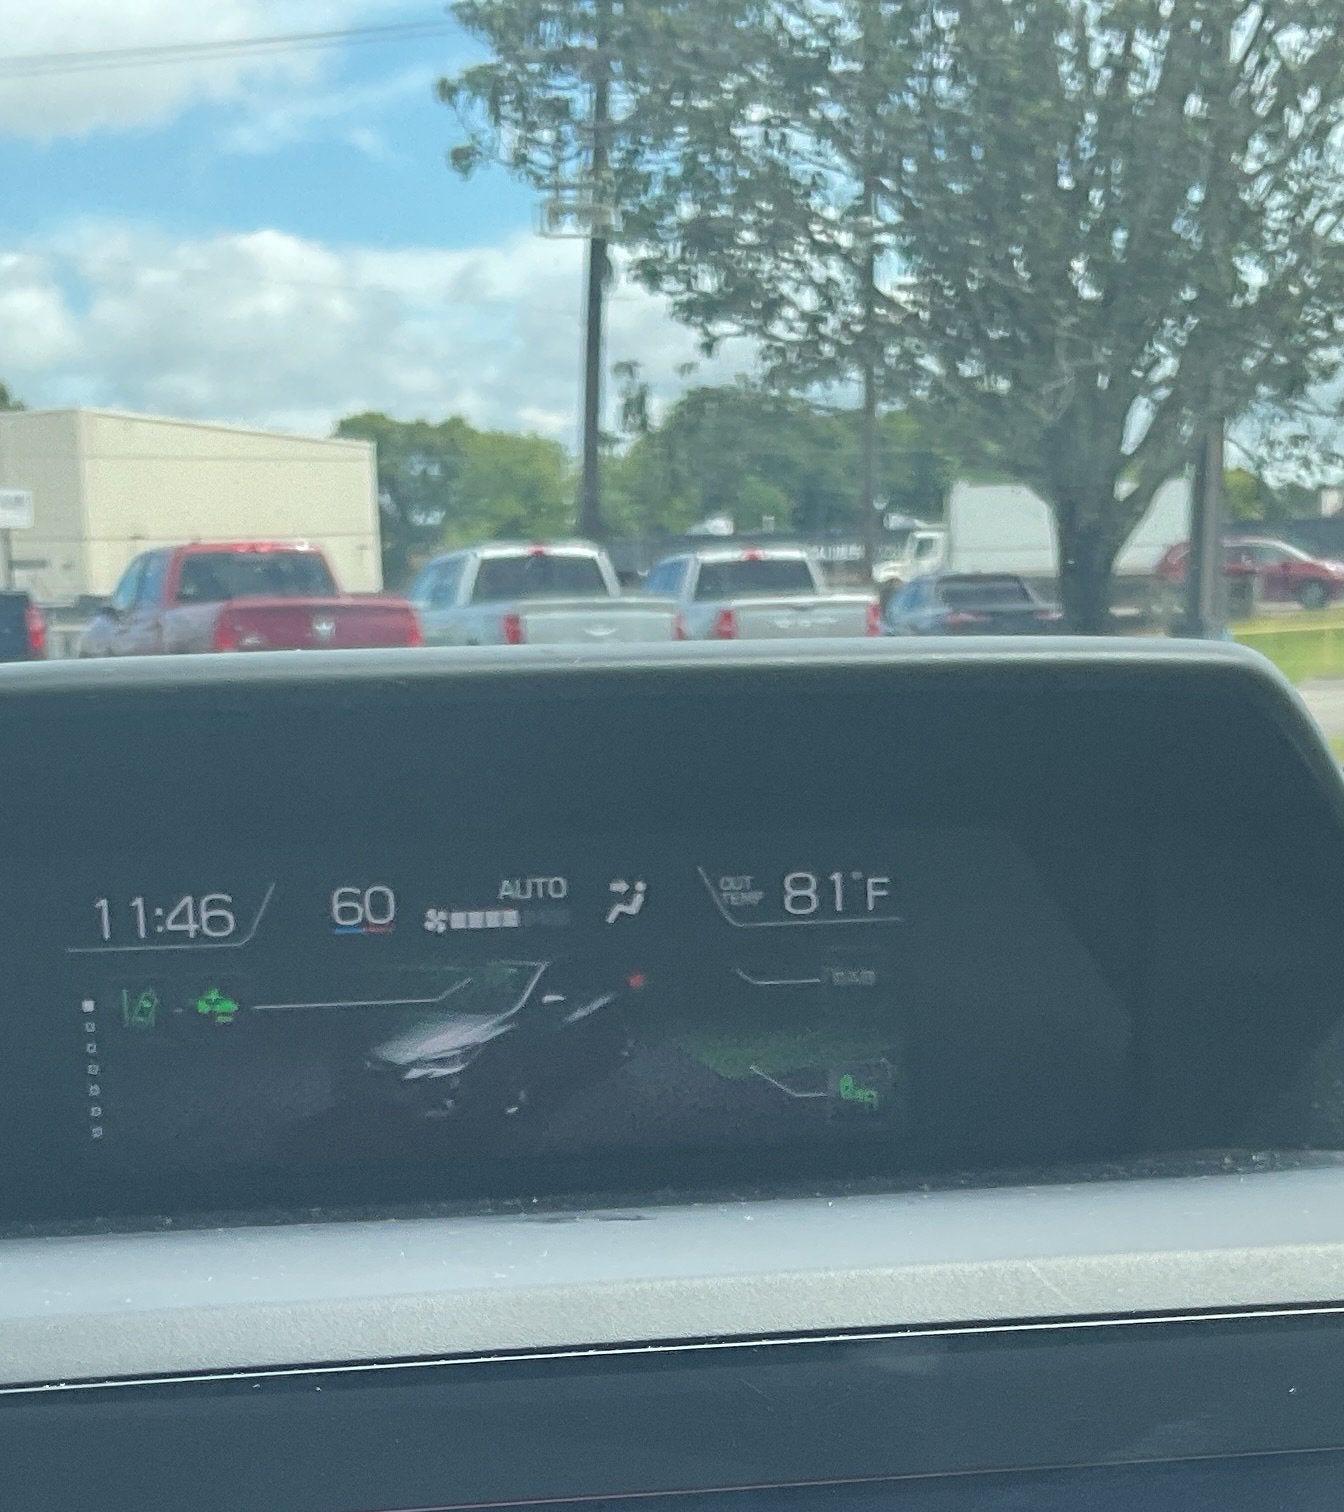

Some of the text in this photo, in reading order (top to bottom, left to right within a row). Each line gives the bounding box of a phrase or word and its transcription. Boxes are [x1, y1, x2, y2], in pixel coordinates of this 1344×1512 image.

[332, 886, 395, 926] 60
[498, 876, 568, 899] AUTO
[95, 893, 235, 939] 11:46
